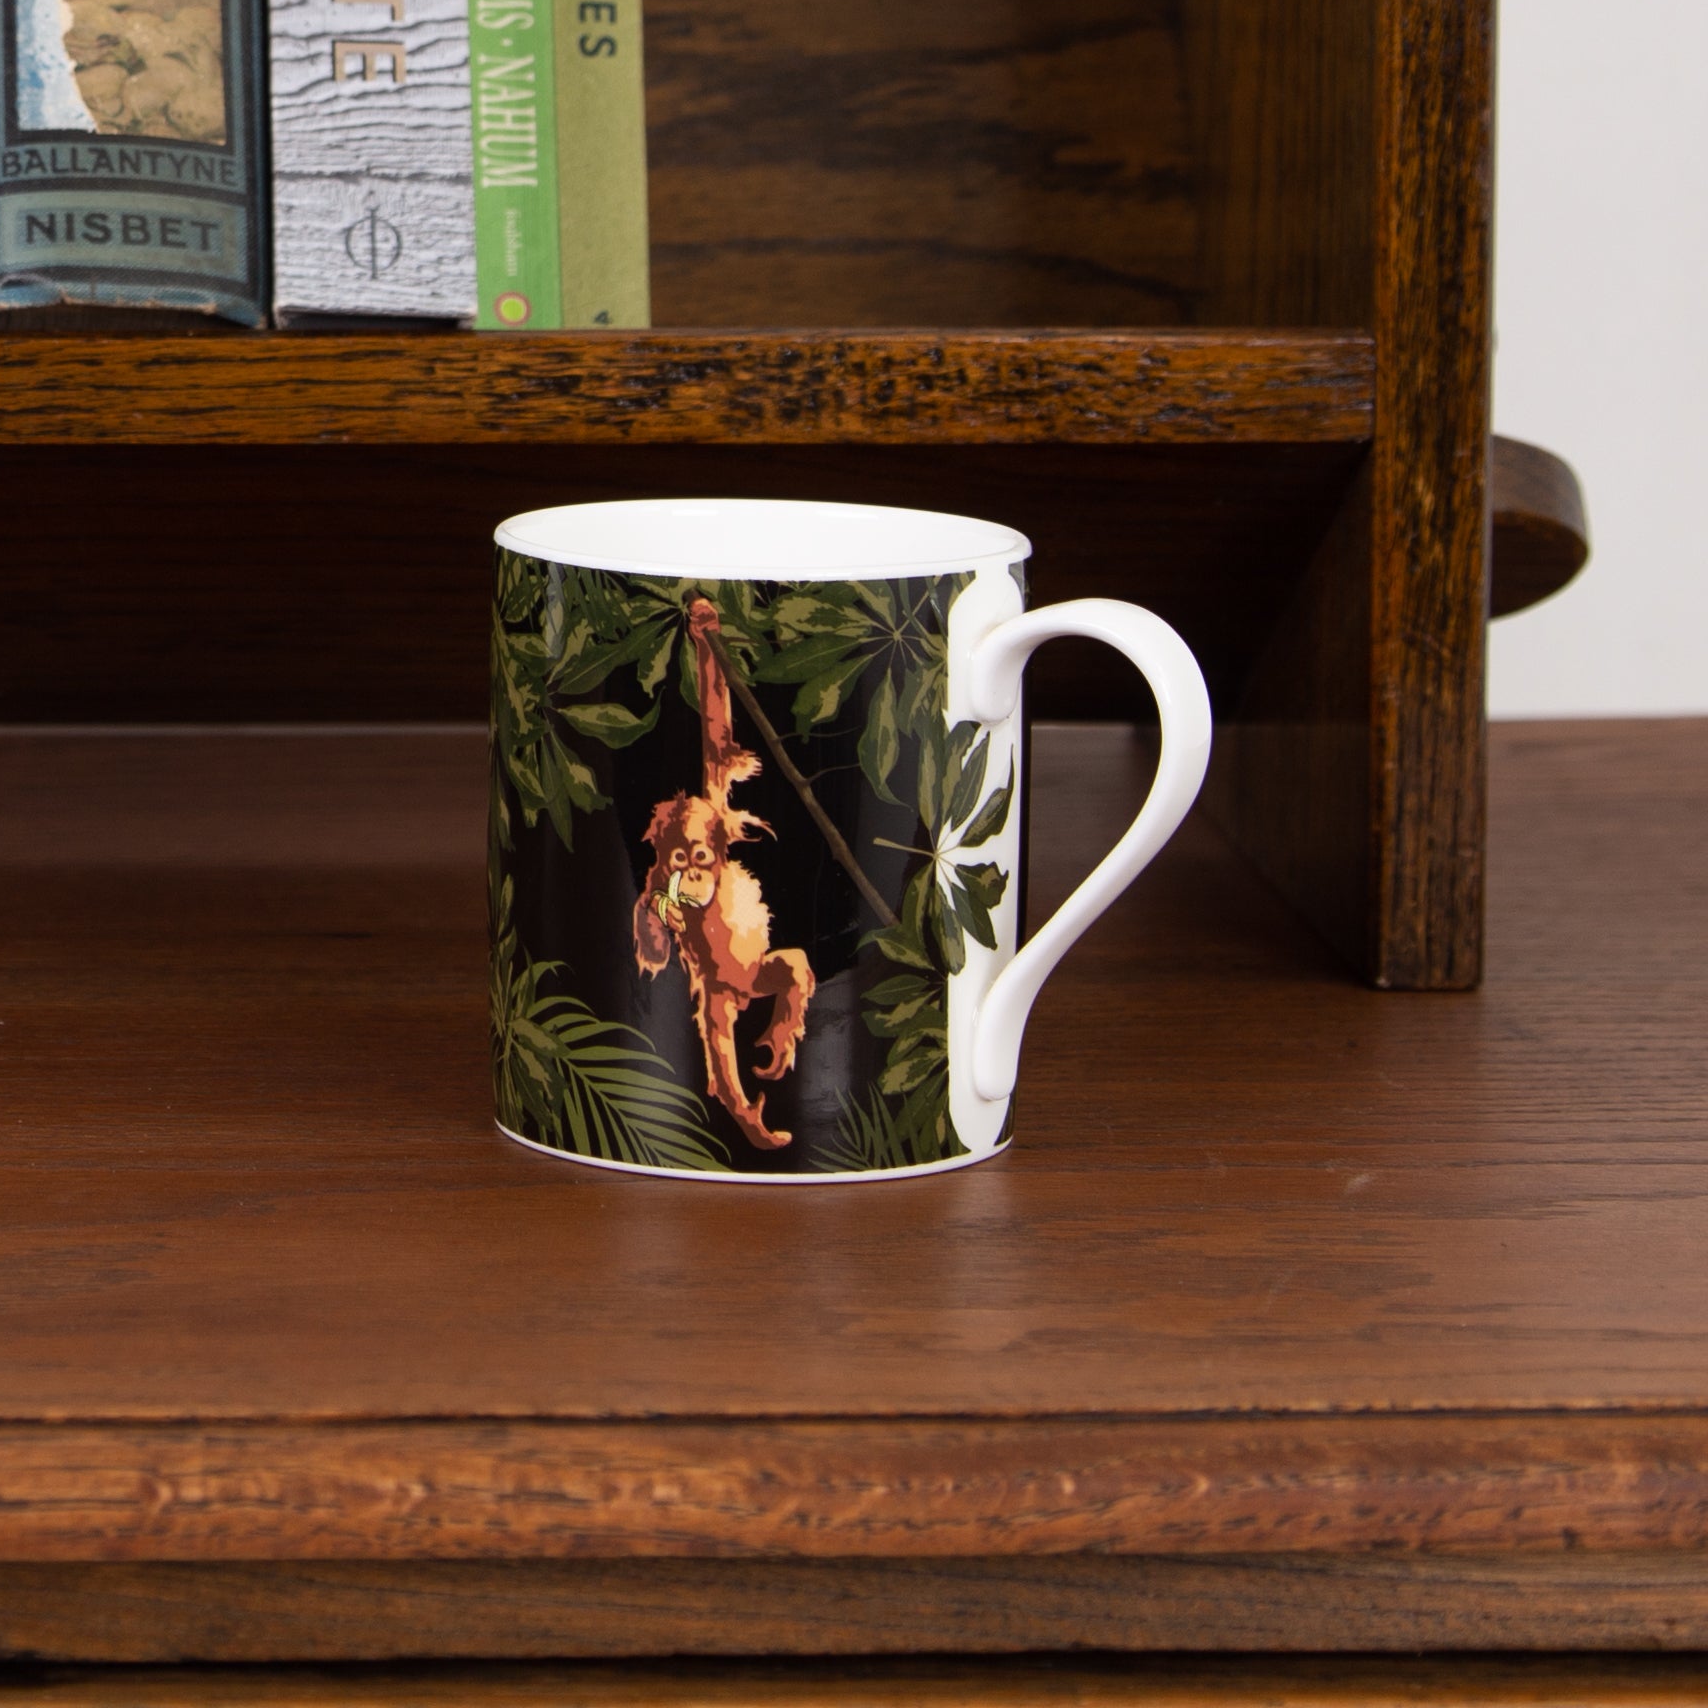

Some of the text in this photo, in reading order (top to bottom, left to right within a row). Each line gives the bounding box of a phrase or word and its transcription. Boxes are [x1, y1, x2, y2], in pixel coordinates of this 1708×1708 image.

[478, 54, 539, 189] NAHUM
[1, 147, 237, 187] BALLANTYNE
[24, 211, 220, 252] NISBET
